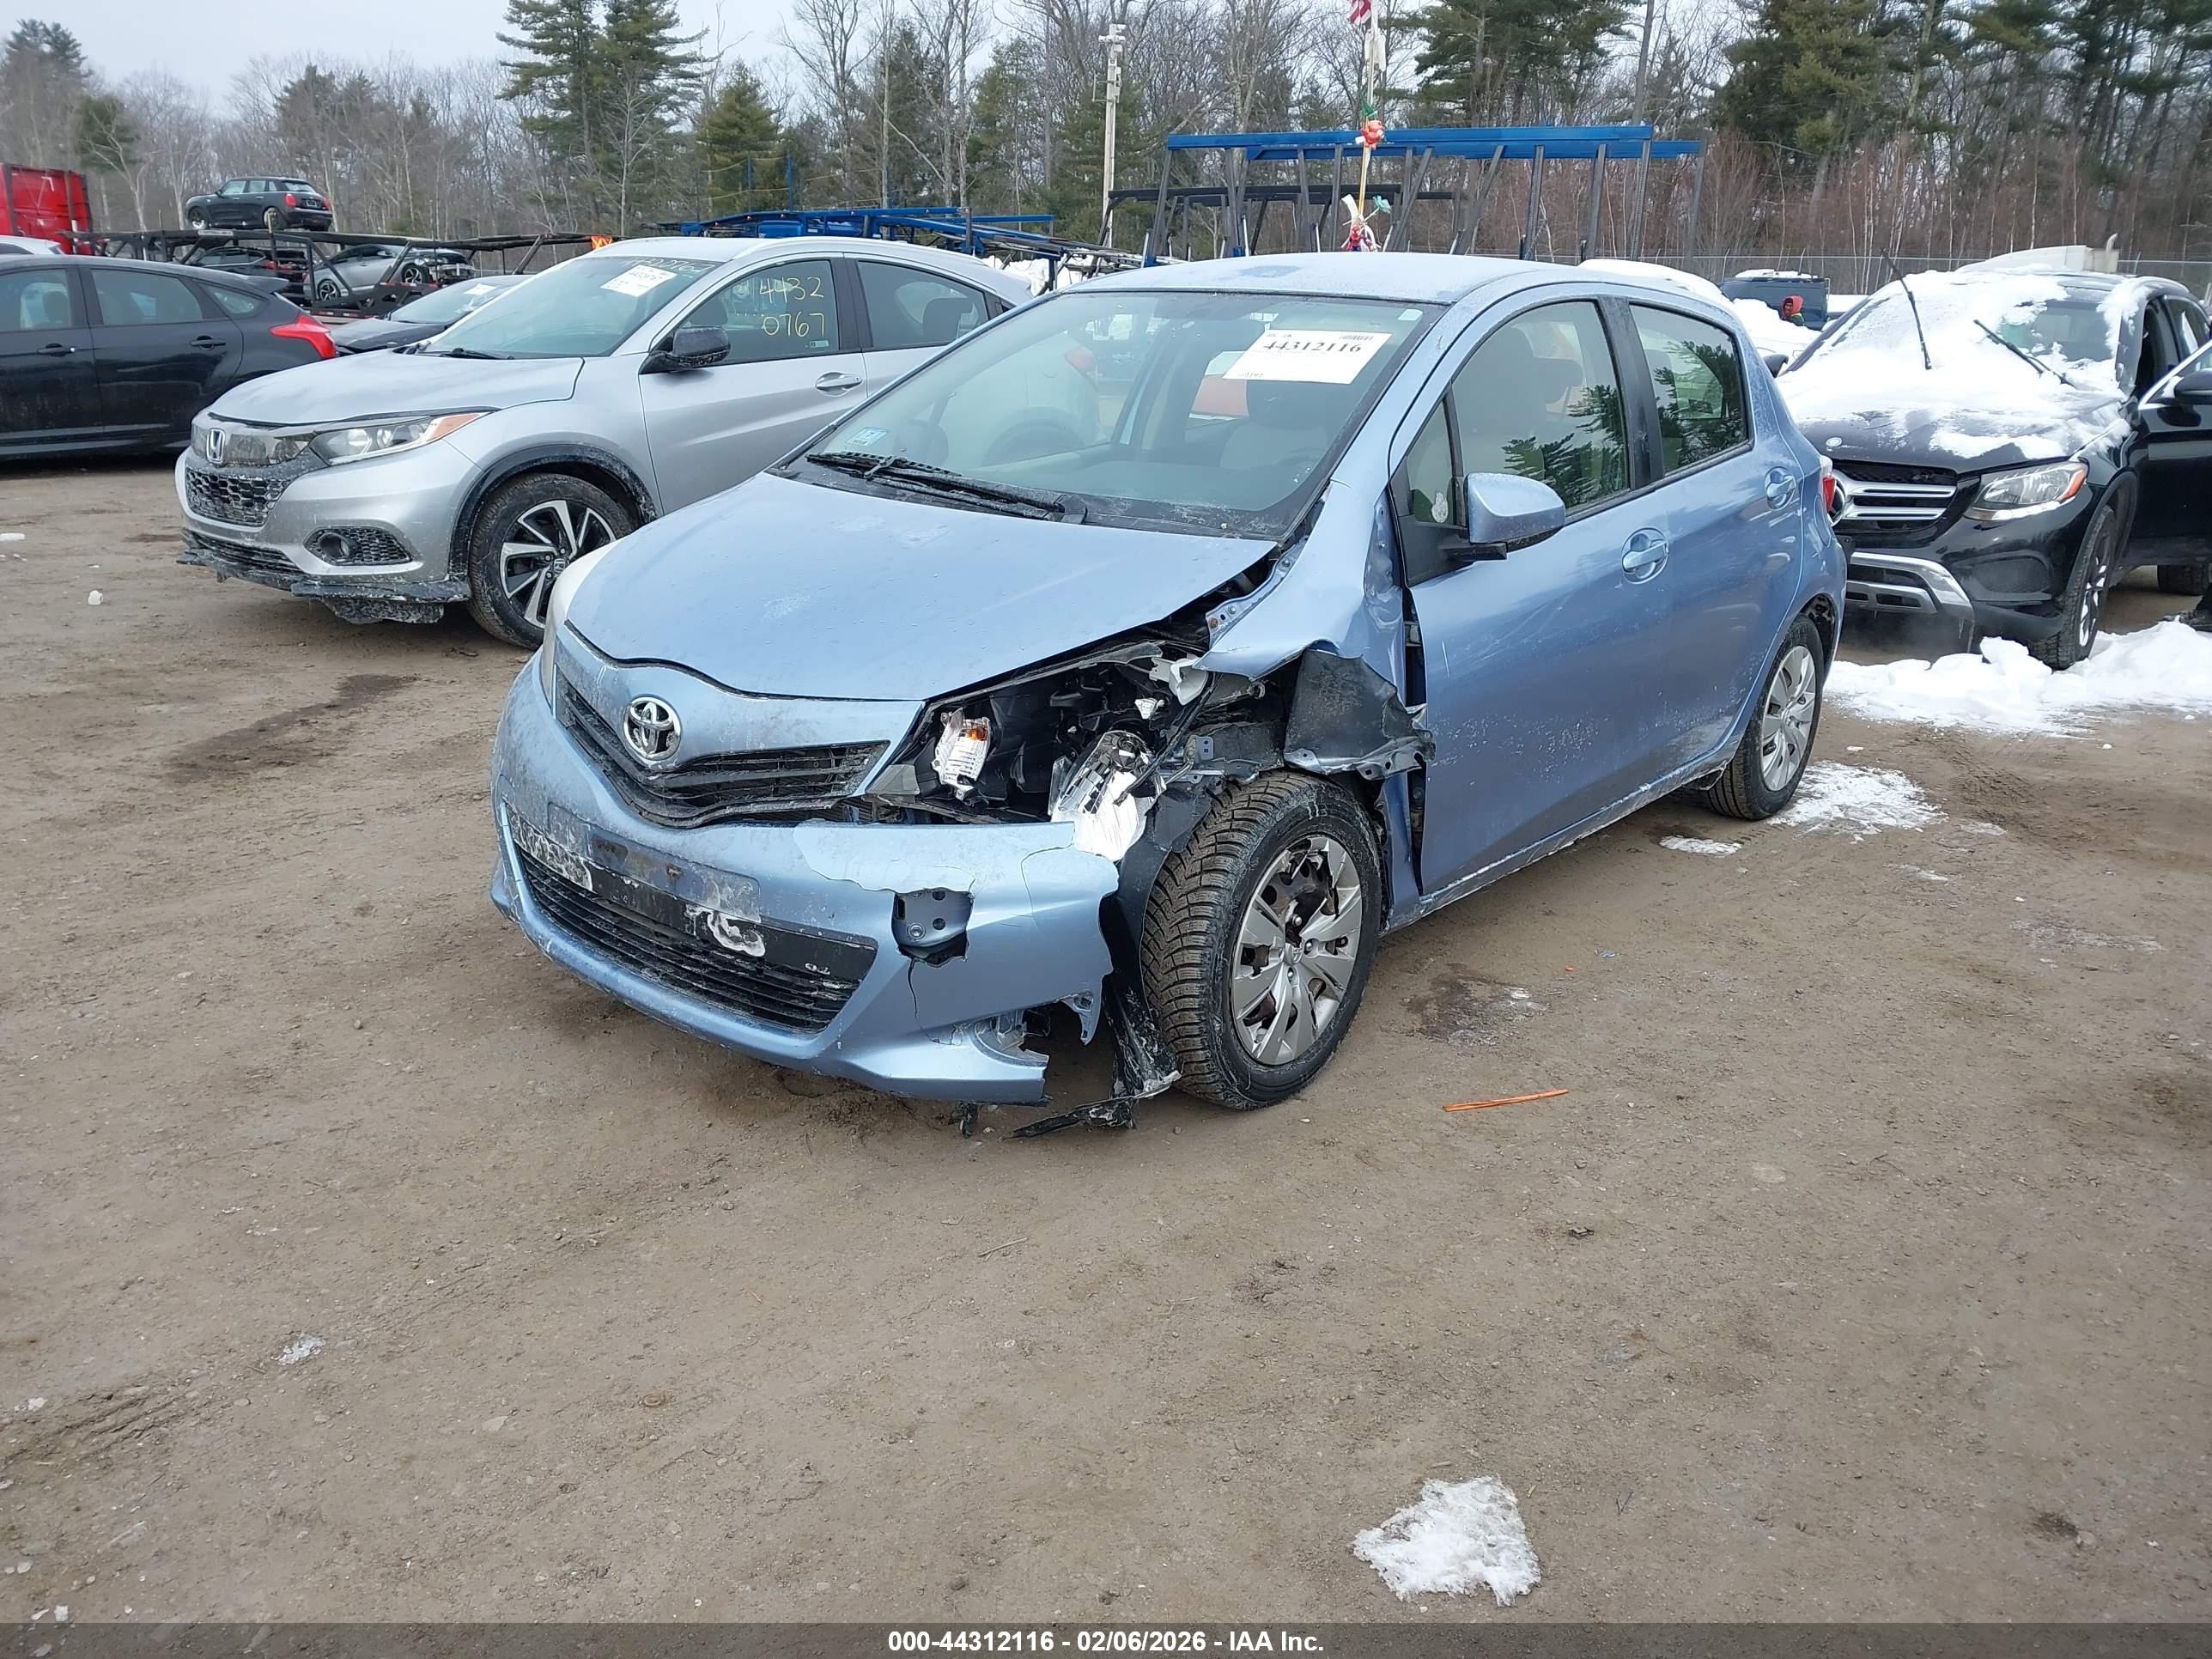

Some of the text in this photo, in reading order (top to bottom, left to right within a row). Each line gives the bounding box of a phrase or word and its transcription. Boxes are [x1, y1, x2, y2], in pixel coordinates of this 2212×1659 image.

[760, 276, 824, 304] 4432
[763, 311, 824, 337] 0767
[1263, 340, 1362, 353] 44312116
